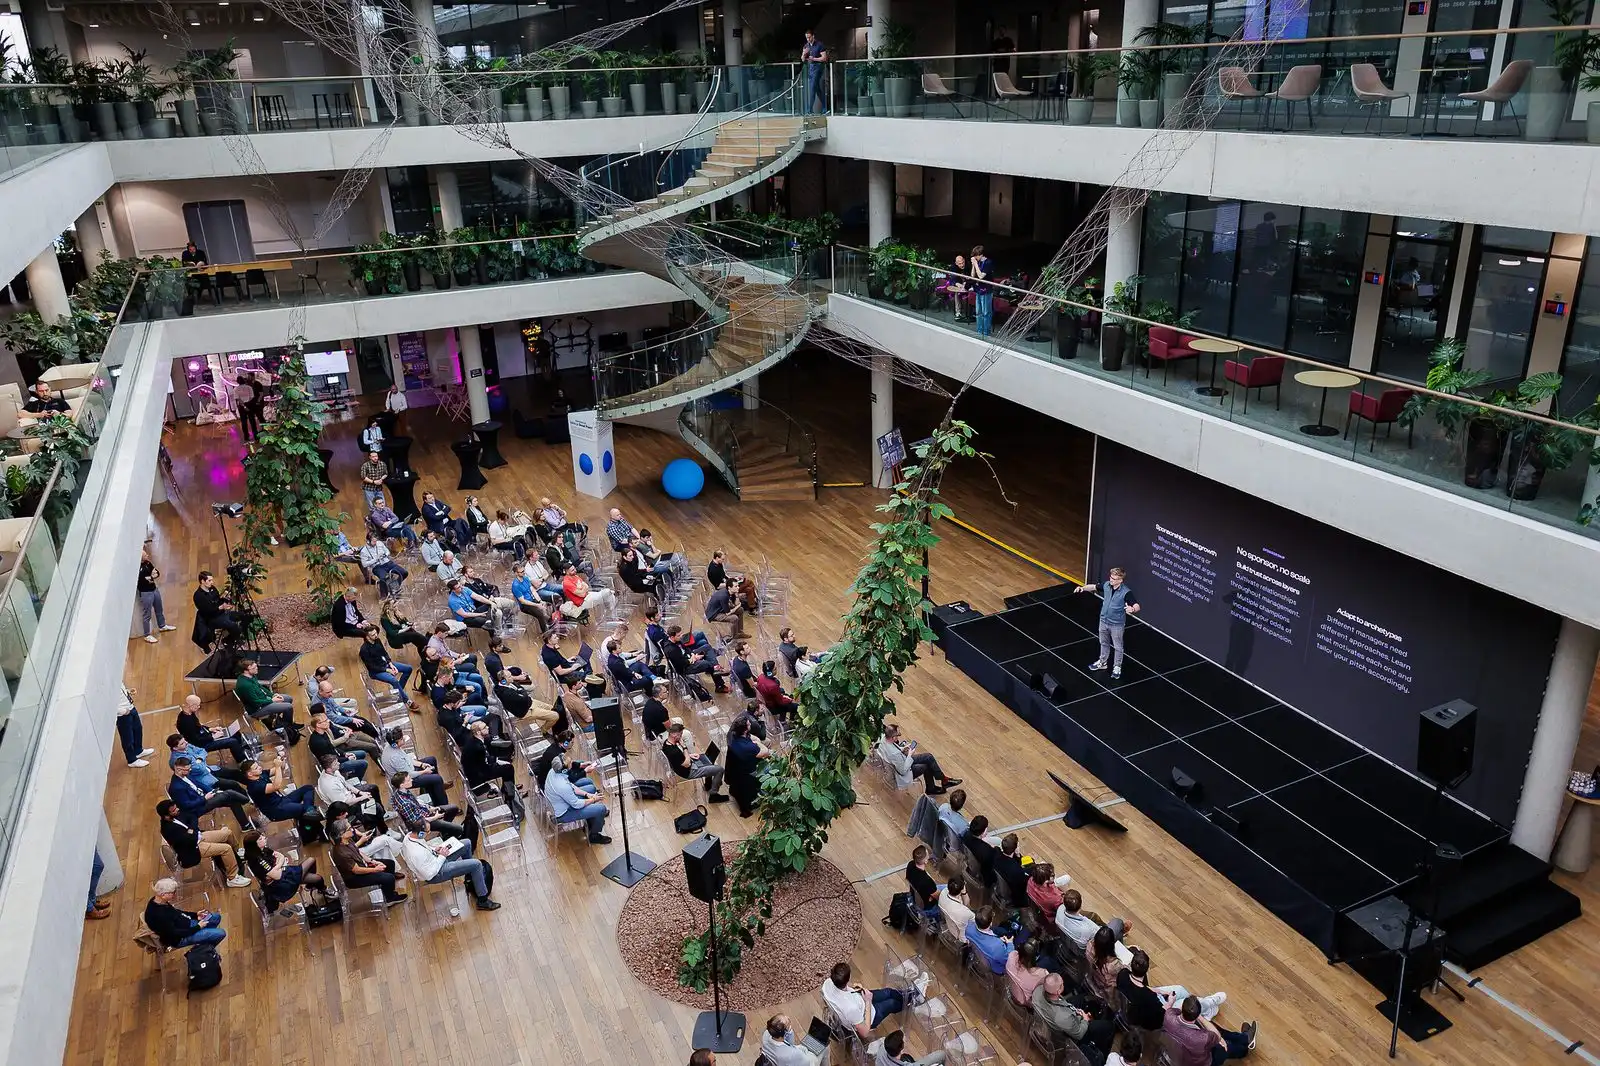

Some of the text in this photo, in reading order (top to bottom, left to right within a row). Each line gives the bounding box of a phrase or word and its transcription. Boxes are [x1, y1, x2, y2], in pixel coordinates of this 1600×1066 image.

[1180, 547, 1191, 555] next
[1198, 545, 1217, 557] growth
[1236, 546, 1311, 585] No sponsor, no scale
[1160, 564, 1171, 573] keep
[1171, 570, 1182, 579] your
[1173, 562, 1190, 573] should
[1190, 570, 1203, 580] grow
[1202, 567, 1217, 577] argue
[1236, 561, 1300, 595] Build trust across layers
[1231, 580, 1260, 599] throughout
[1235, 572, 1297, 605] Cultivate relationships
[1230, 610, 1250, 624] survival
[1251, 620, 1262, 630] and
[1237, 592, 1290, 623] Multiple champions
[1256, 613, 1269, 622] your
[1270, 620, 1284, 630] odds
[1327, 615, 1408, 658] Different managers need
[1336, 608, 1402, 642] Adapt to archetypes
[1317, 633, 1412, 683] what motivates each one and
[1321, 624, 1411, 670] different approaches. Learn
[1317, 643, 1410, 694] tailor your pitch accordingly.
